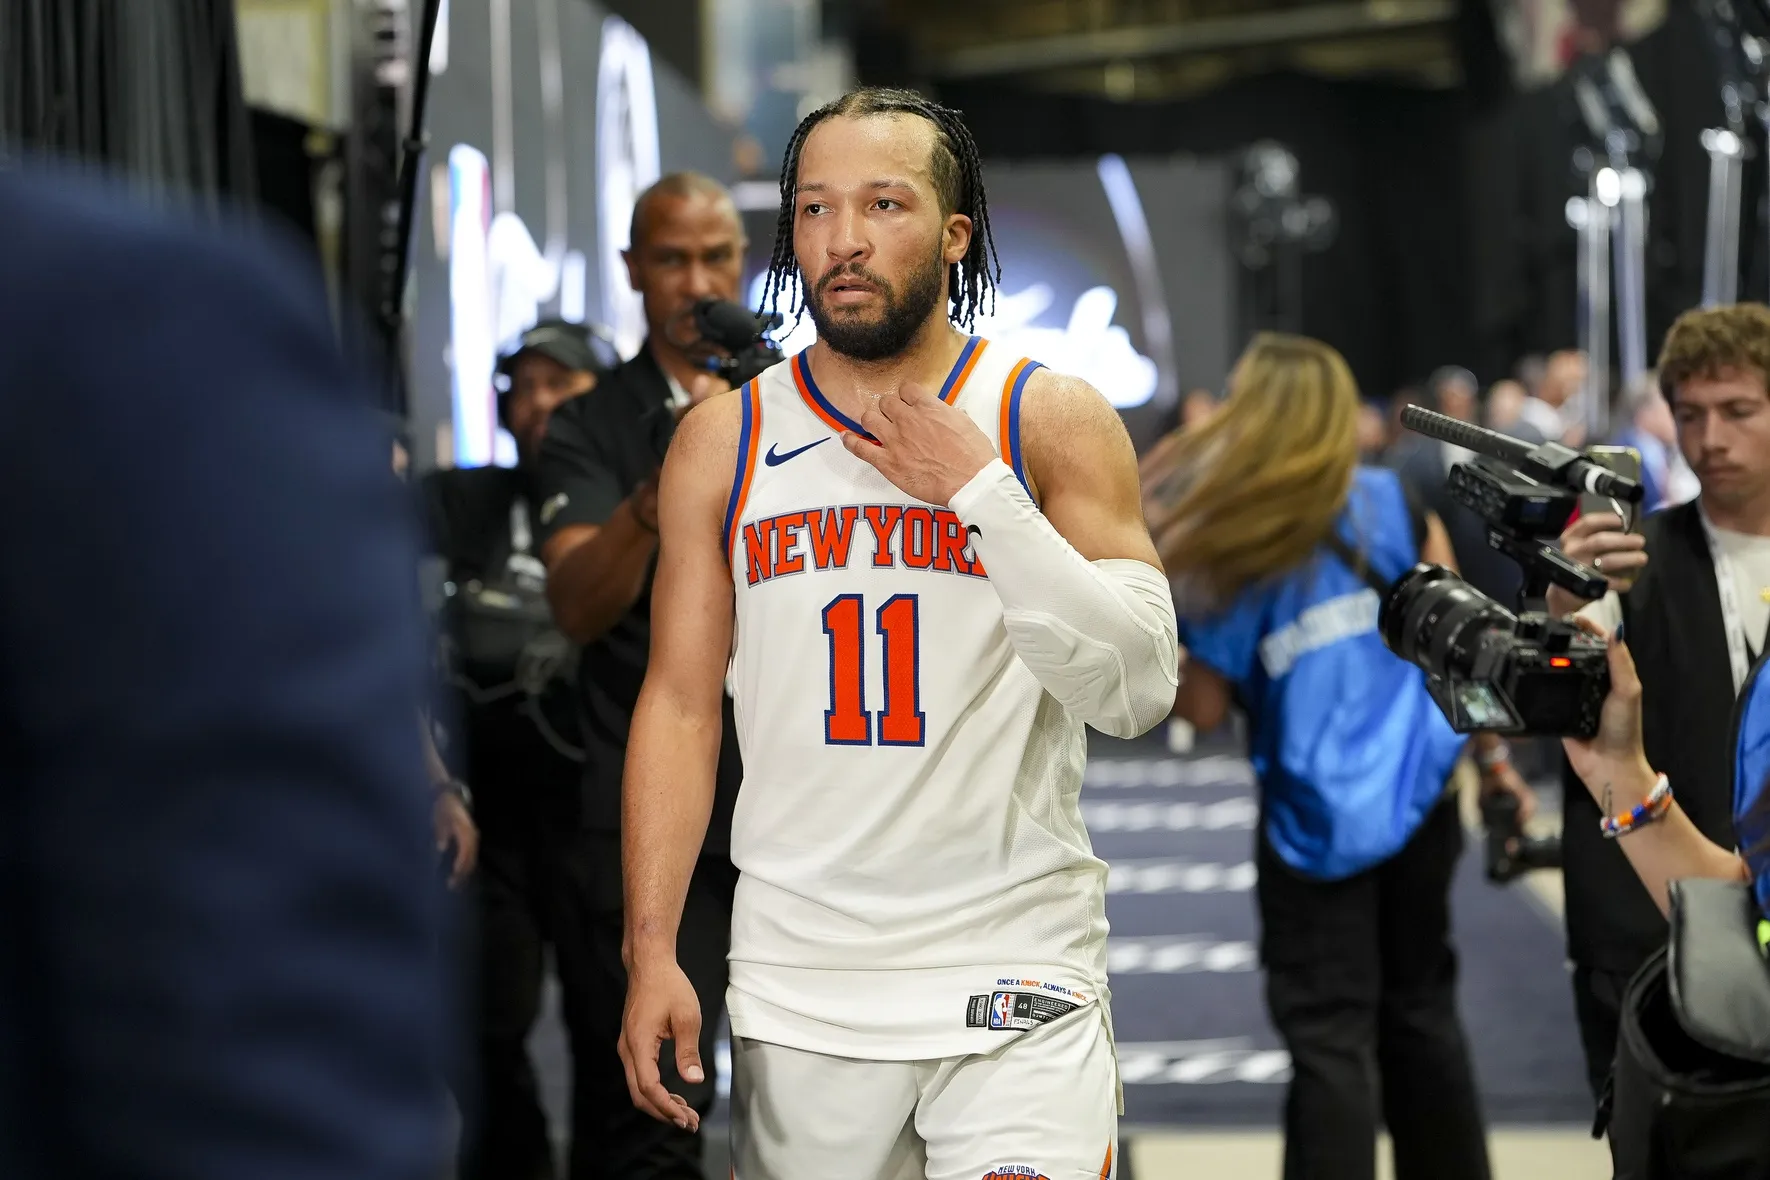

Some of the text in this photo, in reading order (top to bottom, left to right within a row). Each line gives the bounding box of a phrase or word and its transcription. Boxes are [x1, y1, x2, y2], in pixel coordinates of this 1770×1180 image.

[742, 505, 861, 588] NEW
[822, 593, 926, 747] 11
[1043, 983, 1066, 994] ALWAYS
[998, 1164, 1015, 1175] NEW
[1016, 1165, 1036, 1176] YORK
